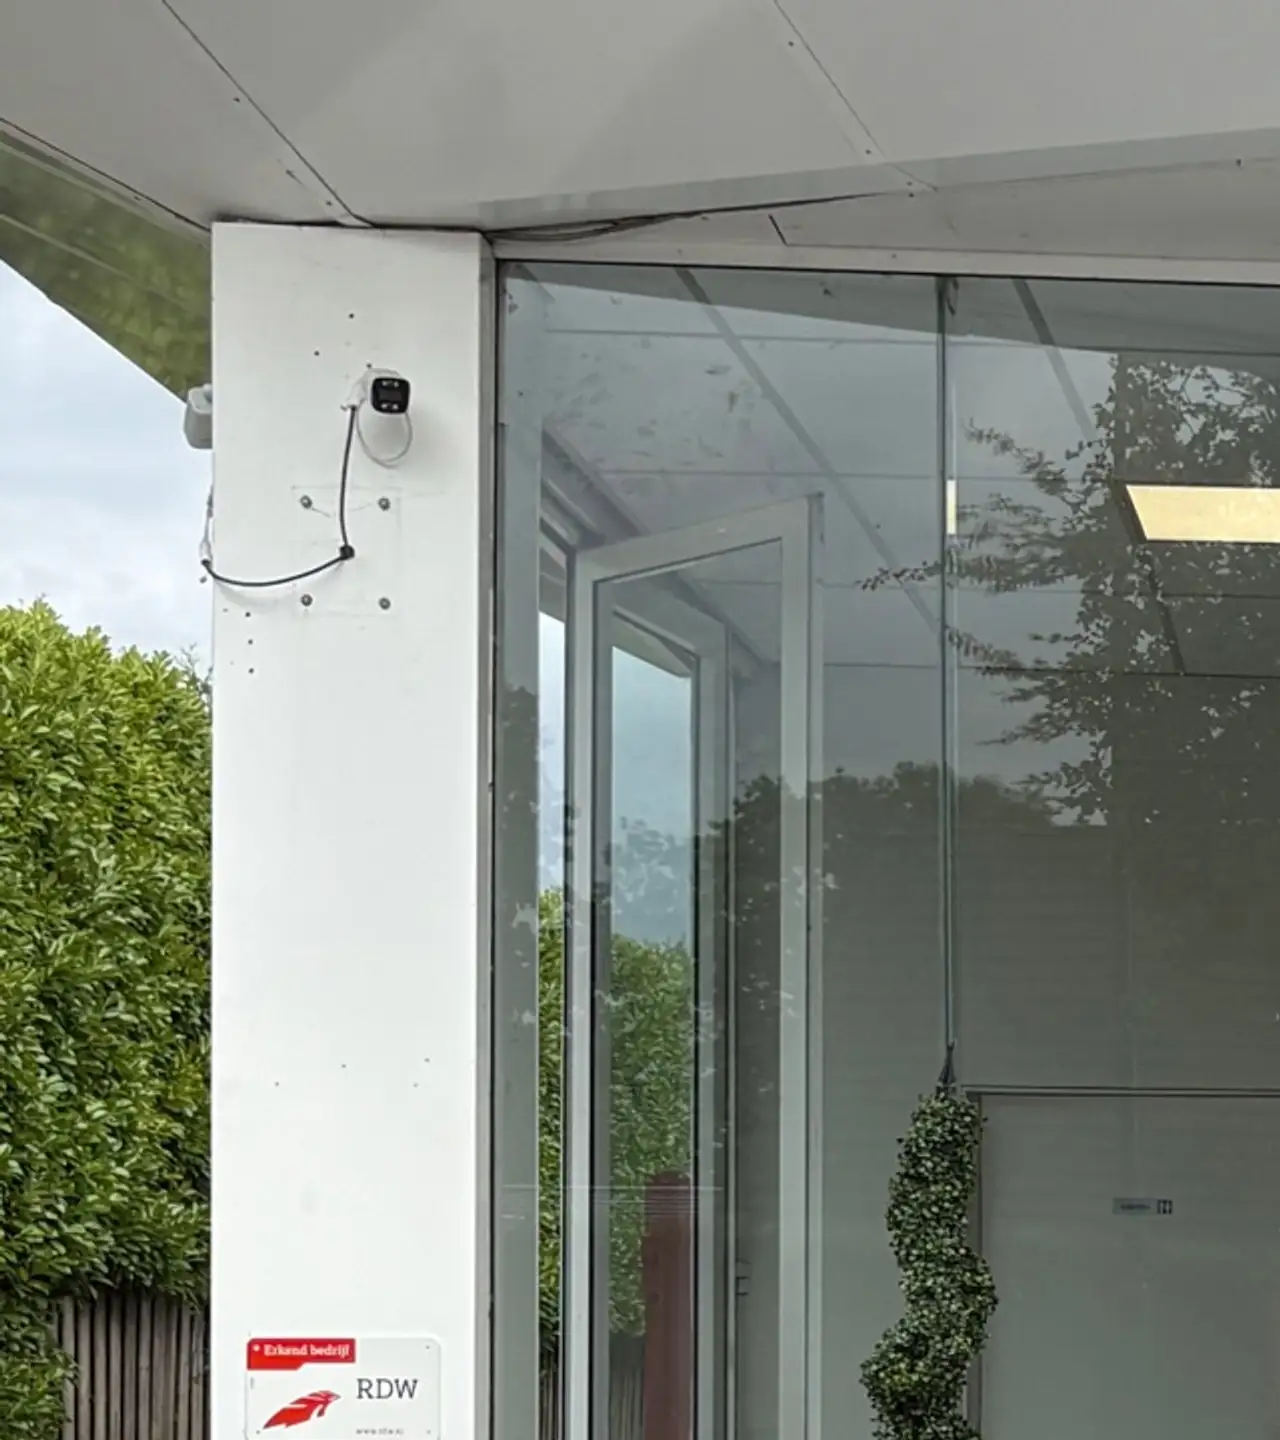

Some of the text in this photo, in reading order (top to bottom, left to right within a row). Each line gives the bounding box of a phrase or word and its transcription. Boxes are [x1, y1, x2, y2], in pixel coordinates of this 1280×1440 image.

[263, 1343, 350, 1359] Erkend bedrijf
[356, 1377, 419, 1400] RDW
